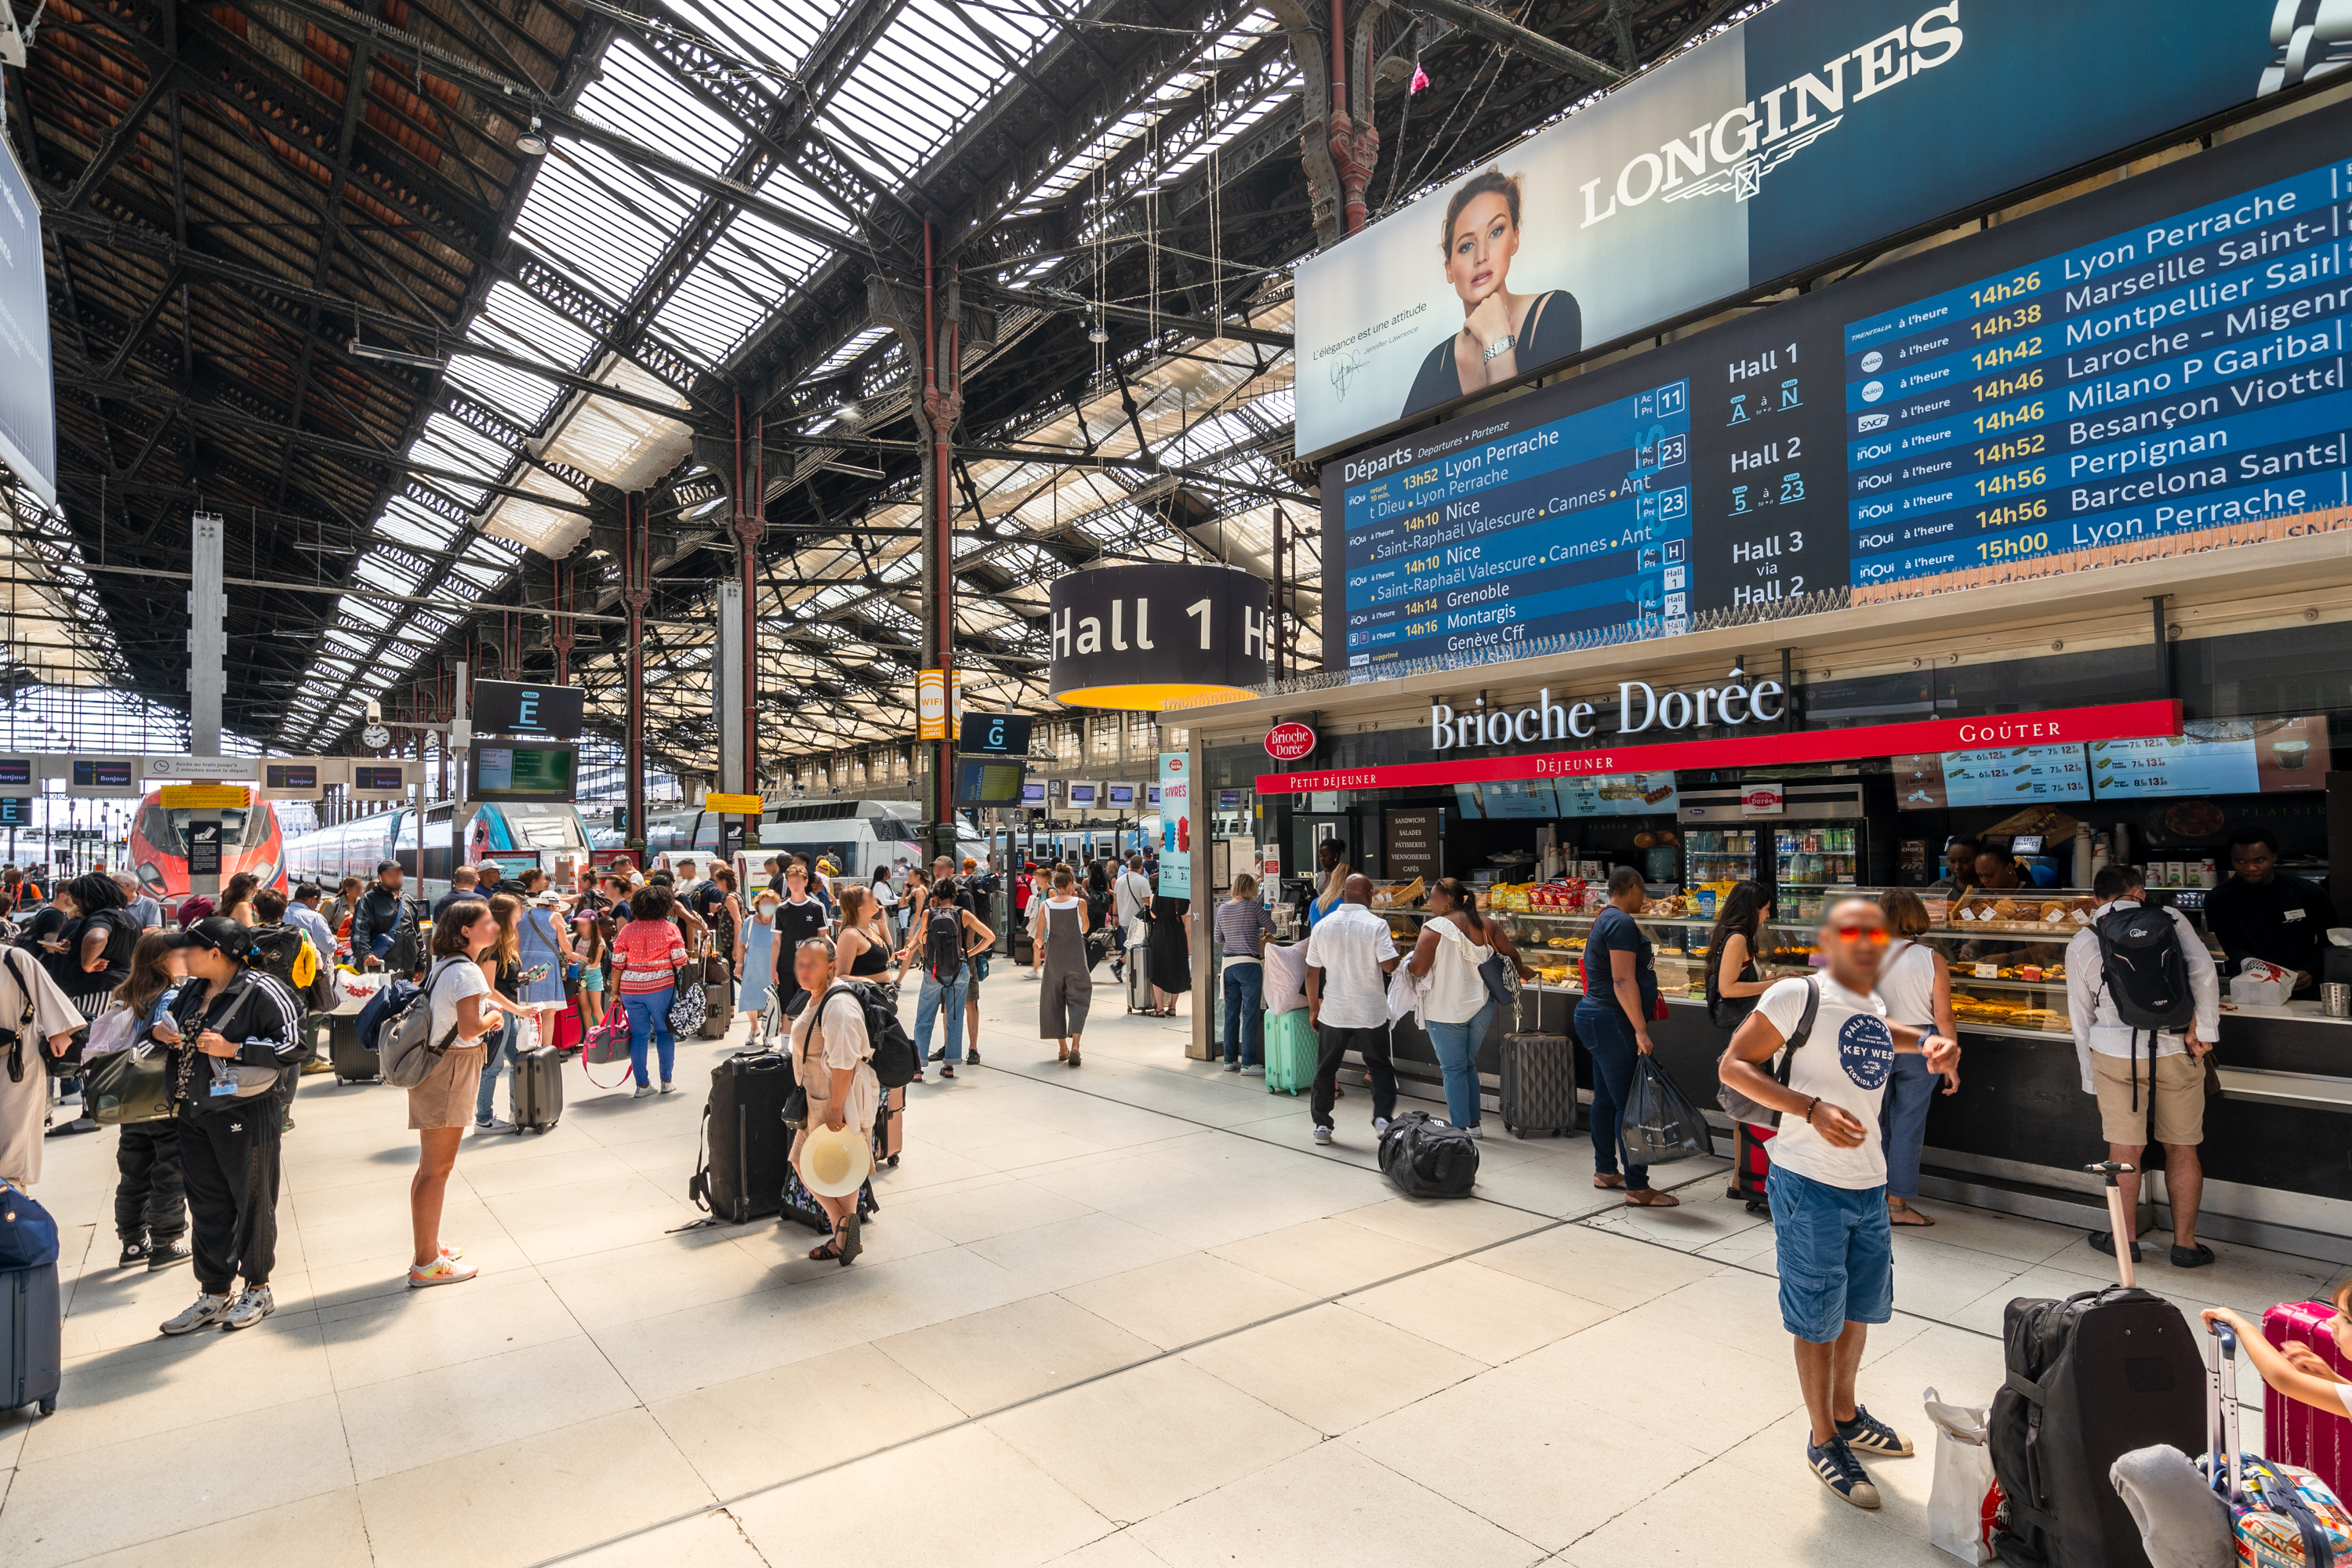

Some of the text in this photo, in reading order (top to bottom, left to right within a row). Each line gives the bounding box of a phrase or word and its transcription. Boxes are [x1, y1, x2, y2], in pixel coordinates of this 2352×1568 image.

[1580, 0, 1962, 229] LONGINES
[1851, 192, 2296, 341] TRENITALIA l'heure 14h26 Lyon Perrache
[1909, 222, 2326, 355] l'heure 14h38 Marseille Saint-
[1313, 302, 1427, 361] L'élégance est une attitude
[1363, 325, 1418, 354] Jennifer Lawrence
[1910, 277, 2254, 386] l'heure 14h42 Montpellier
[1730, 343, 1796, 383] Hall 1
[1860, 416, 1887, 430] SNCF
[1972, 368, 2044, 402] 14h46
[2067, 332, 2188, 378] Laroche
[1973, 332, 2329, 434] 14h46 Milano P Gariba
[1661, 390, 1680, 408] 11
[1731, 387, 1798, 422] A N
[1973, 434, 2045, 466] 14h52
[2070, 395, 2219, 445] Besançon
[1345, 421, 1509, 482] Départs Departures Partenze
[1403, 430, 1559, 490] 13h52 Lyon Perrache
[1662, 442, 1682, 461] 23
[1731, 437, 1802, 474] Hall 2
[1975, 430, 2227, 497] 14h56 Perpignan
[1370, 484, 1387, 494] retard
[1378, 469, 1508, 517] Dieu Lyon Perrache
[1735, 480, 1804, 512] 5 23
[1976, 444, 2338, 528] 14h56 Barcelona Sants
[1377, 474, 1651, 559] Saint-Raphaël Valescure Cannes Ant
[1403, 501, 1480, 532] 14h10 Nice
[1664, 494, 1683, 514] 23
[1976, 488, 2307, 560] 15h00 Lyon Perrache
[1377, 525, 1652, 600] Saint-Raphaël Valescure Cannes Ant
[1404, 546, 1481, 575] 14h10 Nice
[1669, 545, 1679, 558] H
[1733, 530, 1803, 564] Hall 3
[1666, 568, 1682, 578] Hall
[1671, 579, 1677, 587] 1
[1756, 561, 1778, 576] via
[1404, 583, 1509, 615] 14h14 Grenoble
[1667, 593, 1683, 604] Hall
[1733, 575, 1804, 606] Hall 2
[1405, 604, 1515, 637] 14h16 Montargis
[1671, 605, 1678, 614] 2
[1053, 597, 1211, 661] Hall 1
[1372, 624, 1525, 662] supprimé Genève Cff
[520, 701, 538, 725] E
[1431, 667, 1784, 750] Brioche Dorée
[989, 726, 1004, 746] G
[1272, 729, 1308, 746] Brioche
[1959, 720, 2061, 742] GOÛTER
[1276, 742, 1303, 756] Dorée
[1290, 773, 1377, 788] PETIT DÉJEUNER
[1537, 757, 1613, 775] DÉJEUNER
[975, 767, 984, 800] circulation
[2, 804, 16, 819] E
[2241, 807, 2326, 816] PLAISIR
[1845, 1018, 1866, 1039] PALM
[1843, 1044, 1894, 1061] KEY WEST
[2242, 1533, 2300, 1568] MEXICO
